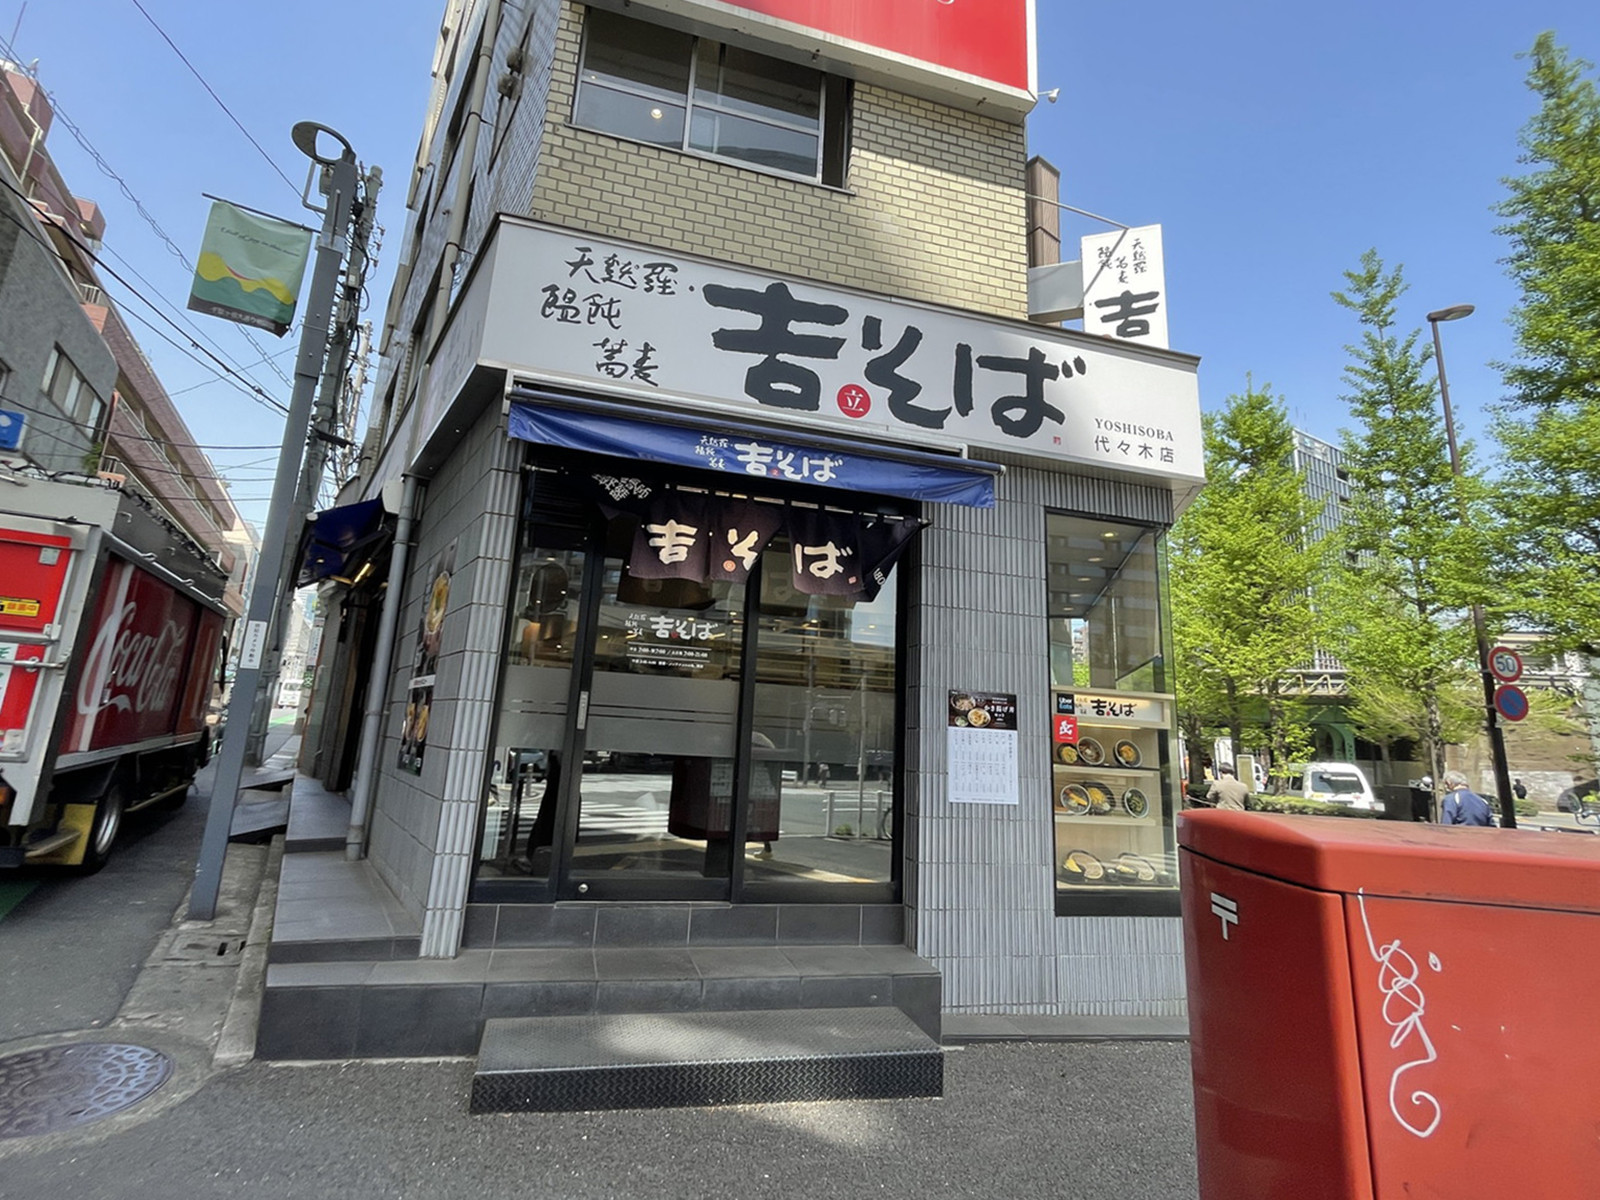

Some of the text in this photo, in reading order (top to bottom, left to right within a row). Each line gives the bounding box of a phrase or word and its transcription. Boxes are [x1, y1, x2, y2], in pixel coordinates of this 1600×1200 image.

[1093, 289, 1160, 338] 吉
[702, 281, 1087, 438] 吉そば
[1094, 417, 1175, 442] YOSHISOBA
[734, 442, 844, 483] 吉そば
[1094, 435, 1176, 464] 代々木店
[649, 615, 719, 640] 吉そば
[1495, 656, 1516, 674] 50
[1090, 698, 1137, 717] 吉そば
